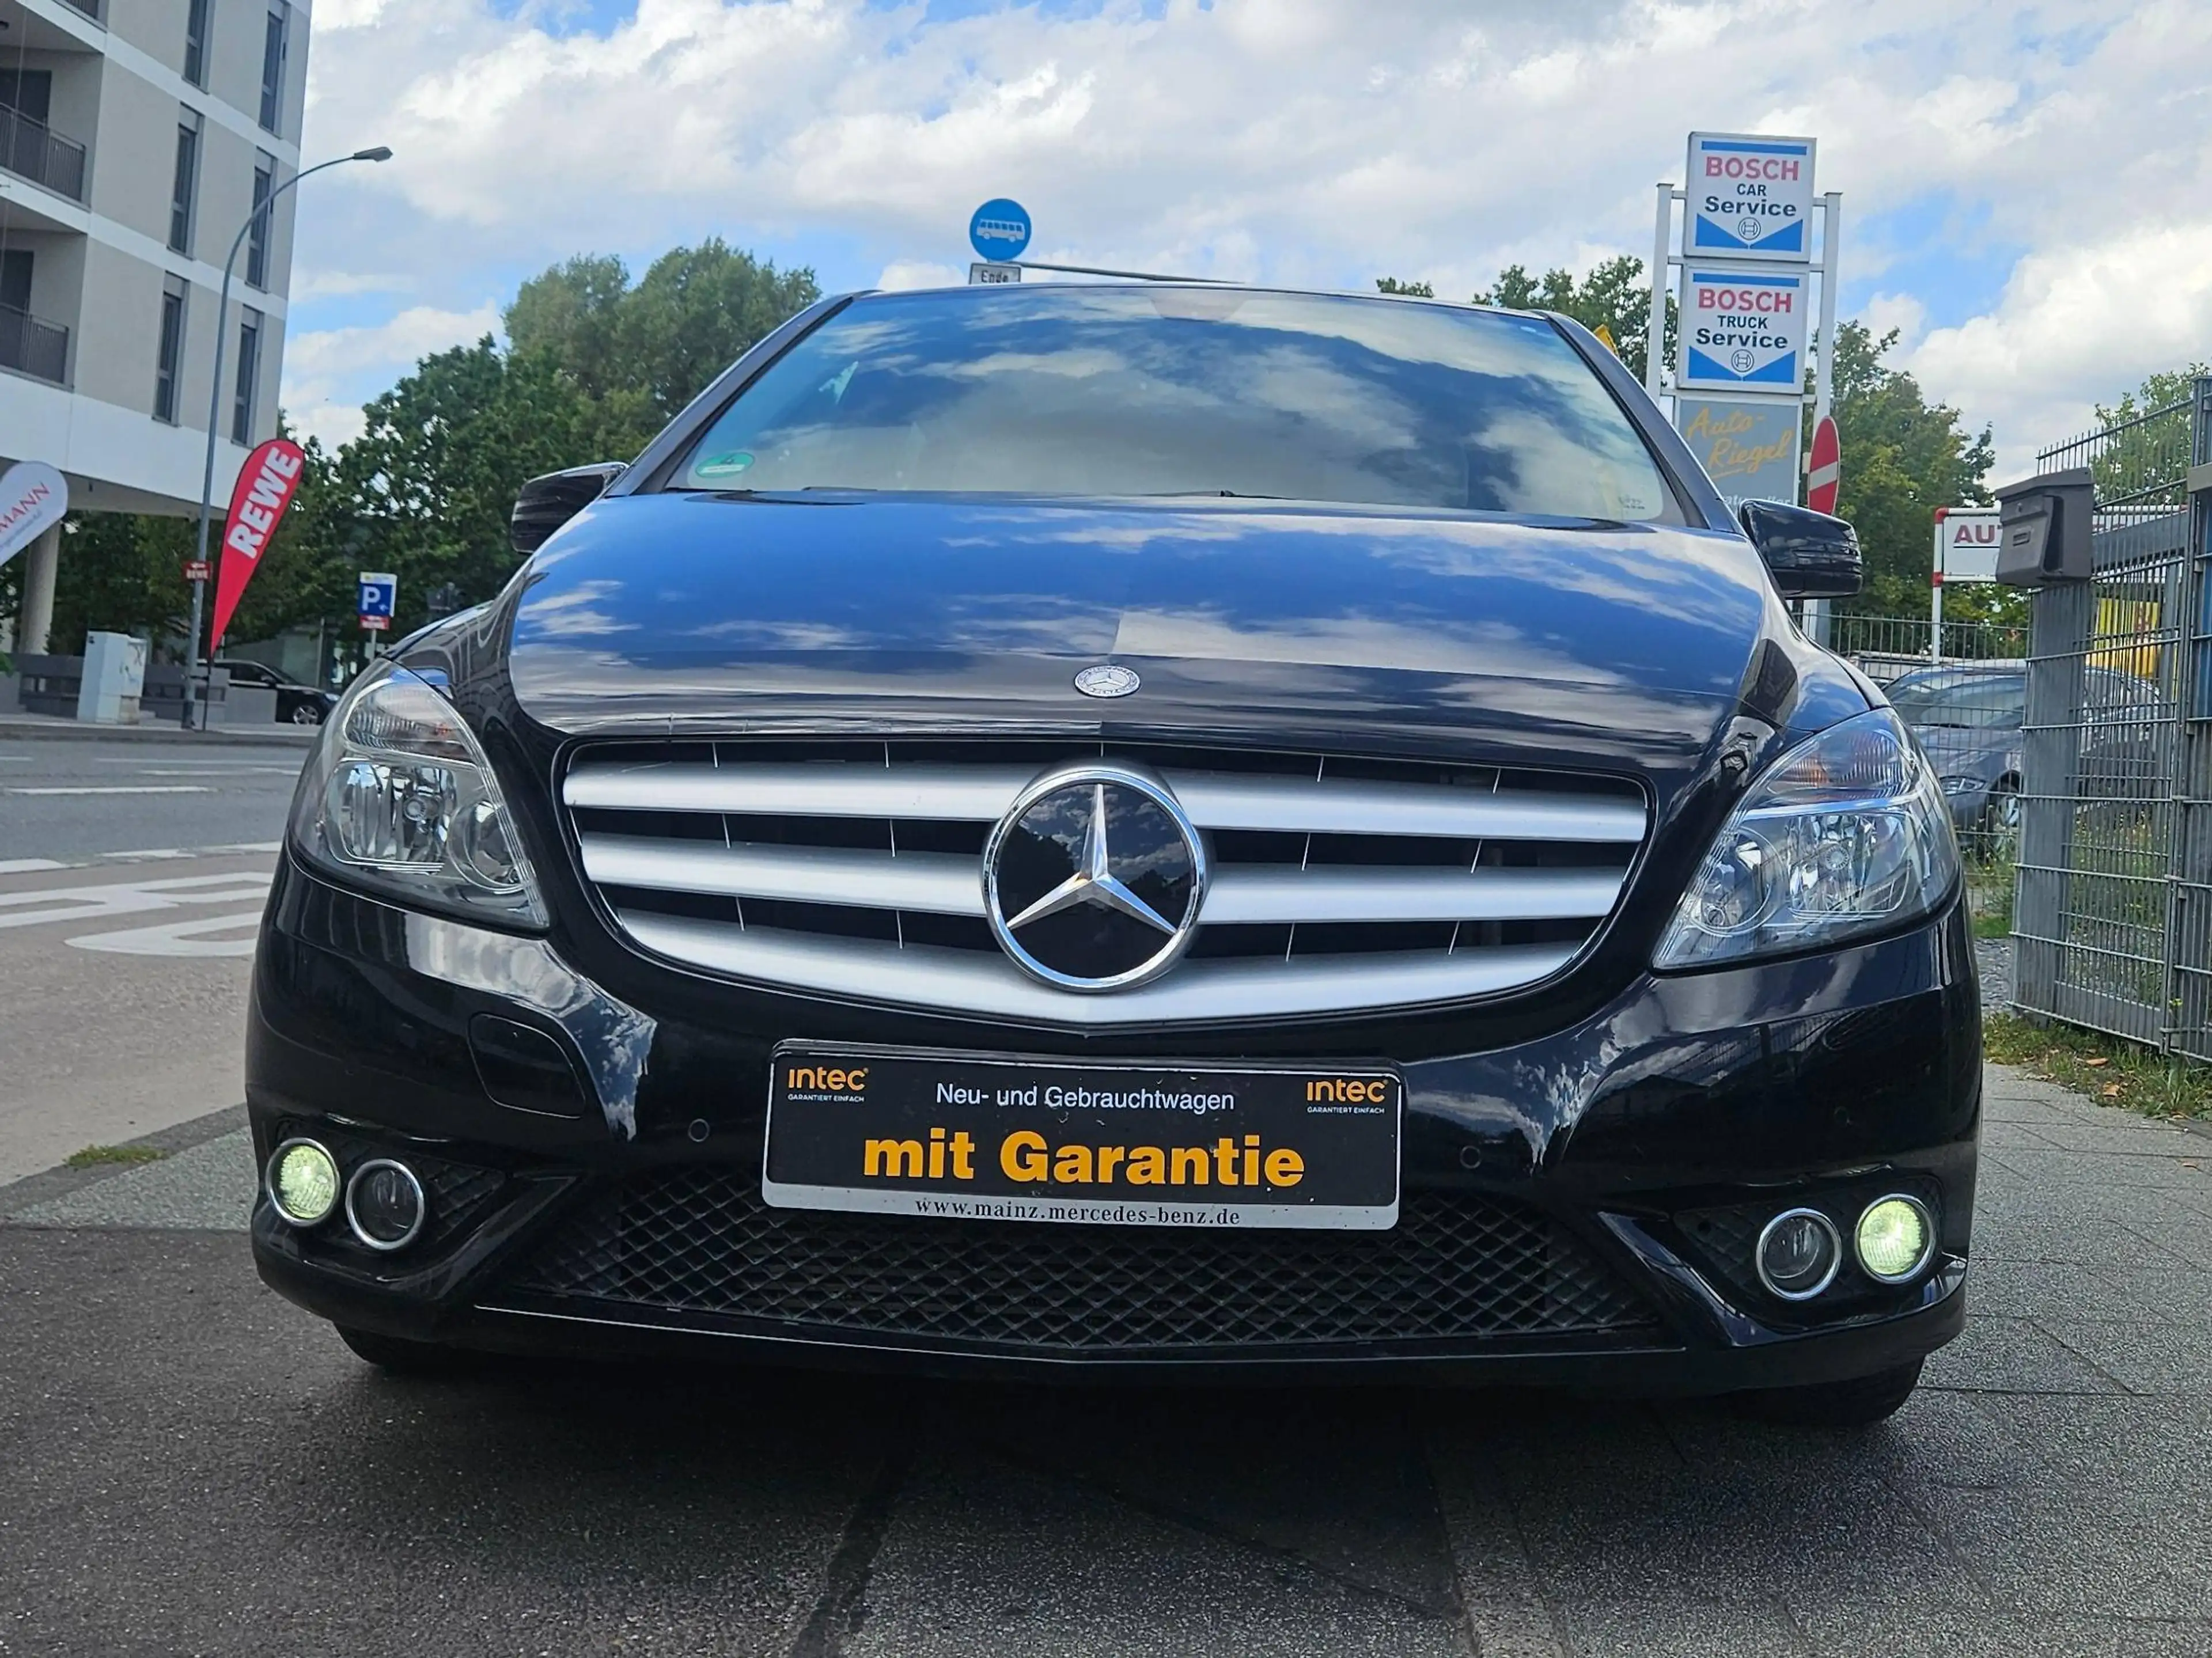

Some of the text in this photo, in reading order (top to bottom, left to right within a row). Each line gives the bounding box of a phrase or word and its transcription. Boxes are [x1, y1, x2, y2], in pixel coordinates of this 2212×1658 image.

[1706, 156, 1799, 181] BOSCH
[1737, 183, 1767, 196] CAR
[1705, 196, 1797, 217] Service
[1698, 289, 1792, 313] BOSCH
[1717, 315, 1768, 329] TRUCK
[1696, 328, 1789, 348] Service
[1687, 407, 1766, 442] Auto-
[1708, 428, 1794, 474] Riegel
[228, 446, 302, 559] REWE
[1953, 524, 2002, 544] AU
[362, 586, 381, 611] P
[788, 1066, 866, 1091] intec
[1306, 1079, 1385, 1103] intec
[787, 1094, 832, 1102] GARANTIERT
[937, 1083, 1234, 1114] Neu- und Gebrauchtwagen
[864, 1128, 1304, 1187] mit Garantie
[915, 1200, 1240, 1226] www.mainz.mercedes-benz.de
